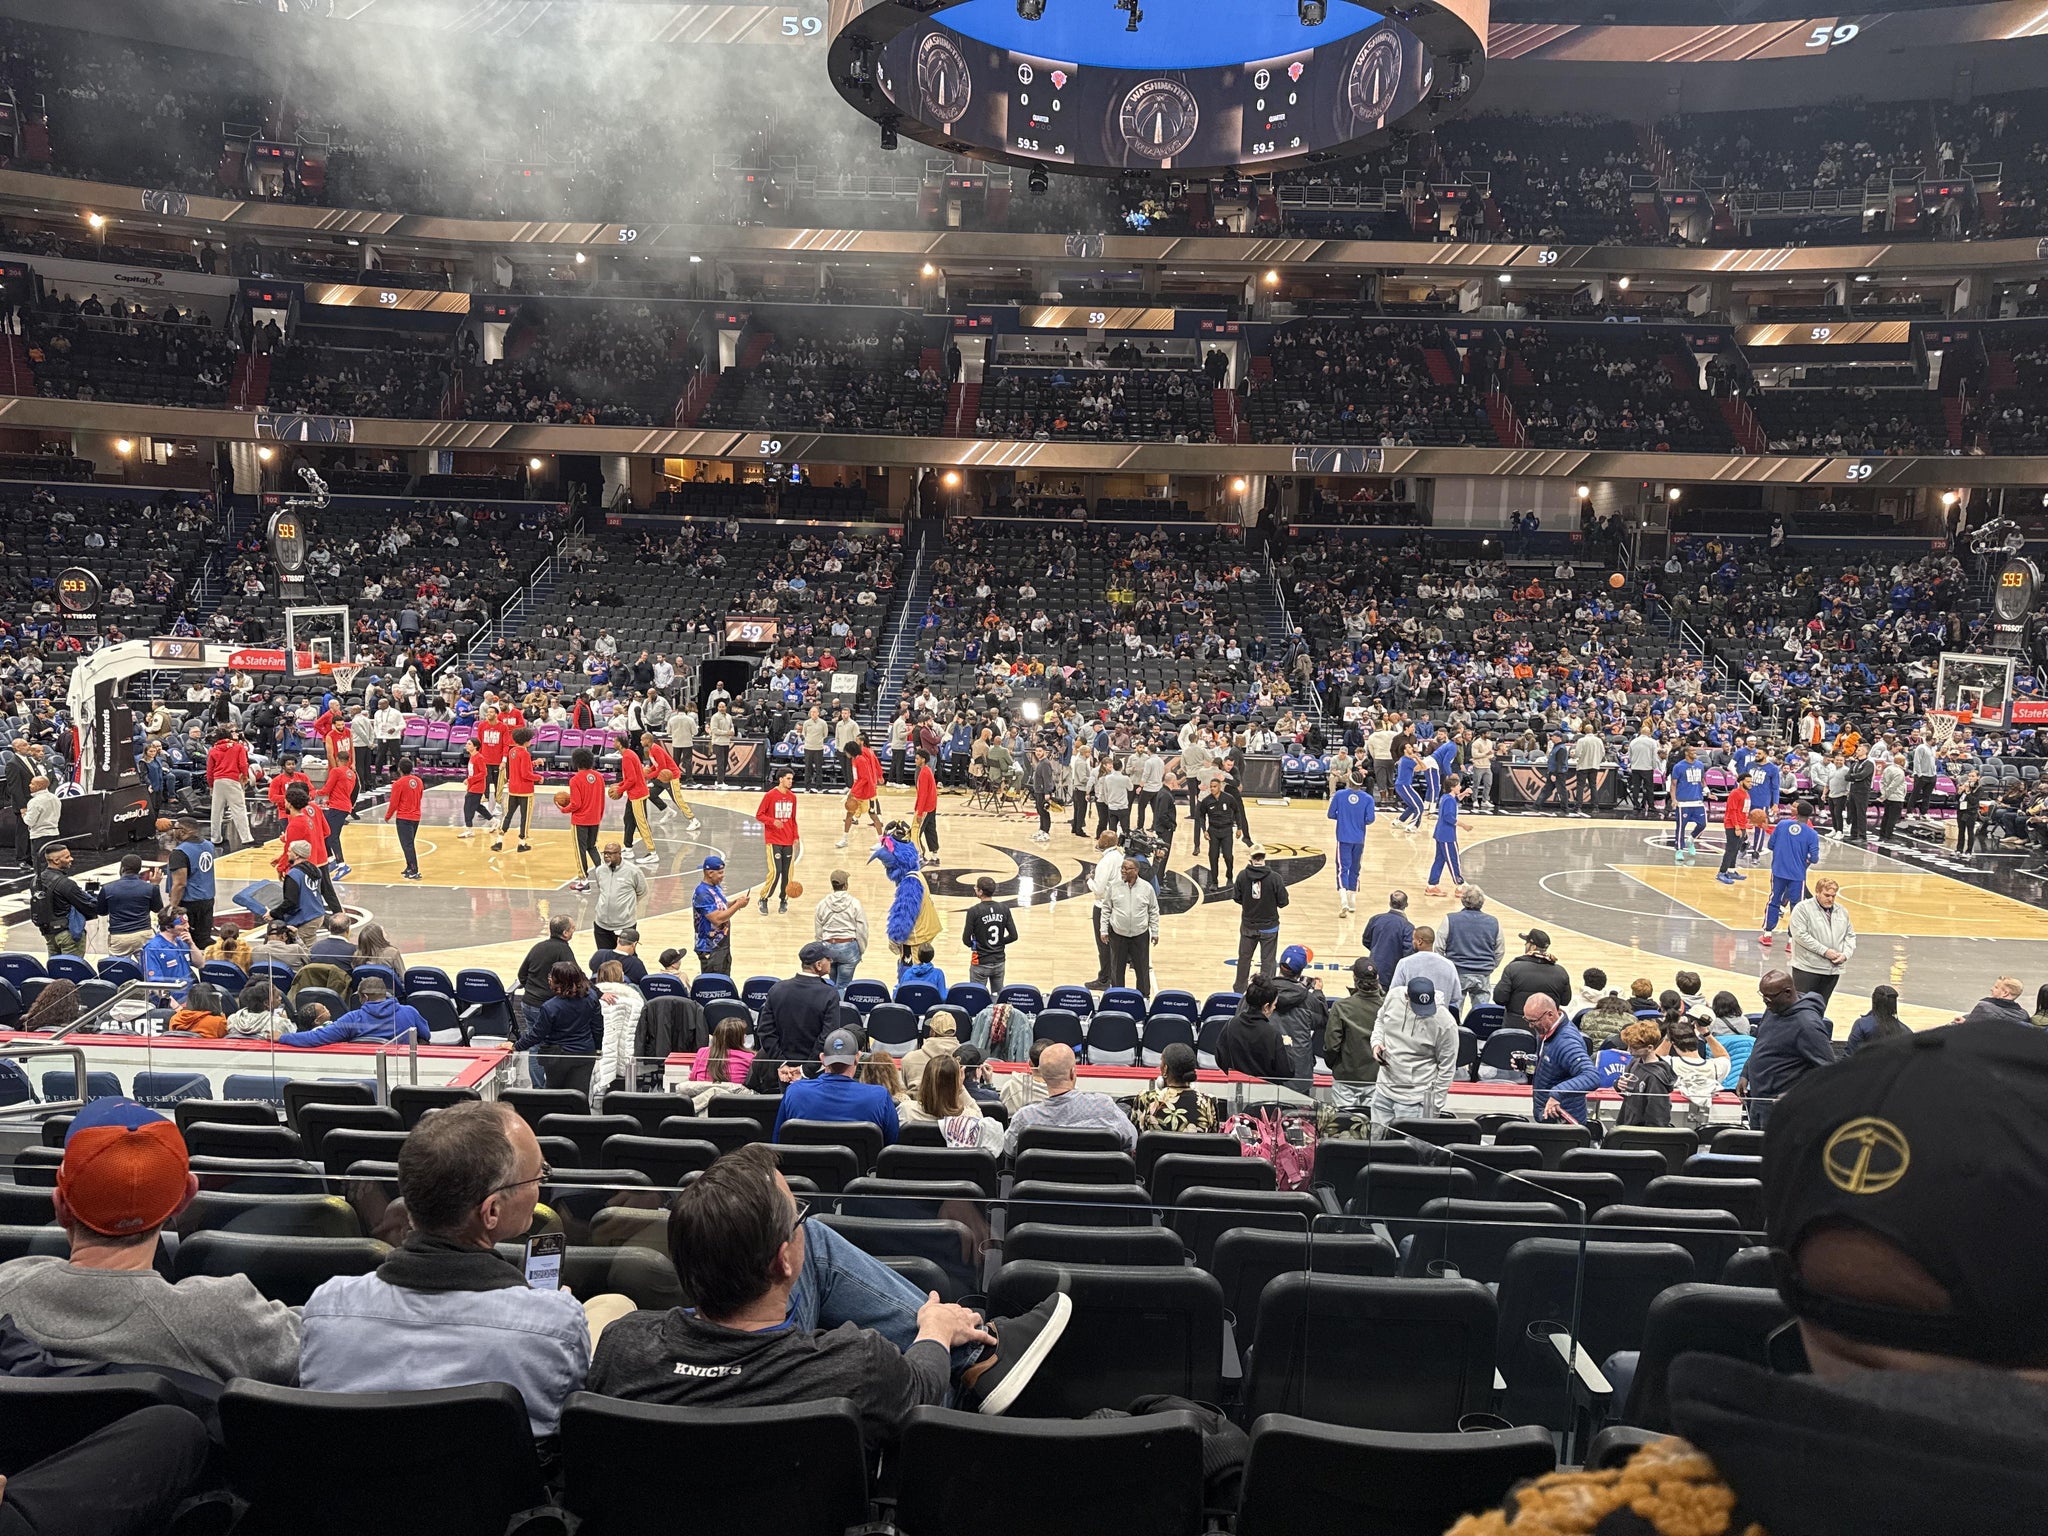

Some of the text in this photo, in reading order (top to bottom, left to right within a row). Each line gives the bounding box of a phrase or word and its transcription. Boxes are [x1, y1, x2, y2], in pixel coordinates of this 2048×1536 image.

[781, 16, 823, 36] 59
[1805, 24, 1859, 47] 59
[1020, 93, 1029, 106] 0
[1052, 99, 1061, 112] 0
[1256, 98, 1265, 111] 0
[1288, 92, 1297, 105] 0
[1017, 137, 1039, 151] 59.5
[1252, 141, 1275, 155] 59.5
[618, 229, 638, 242] 59
[1538, 250, 1558, 264] 59
[379, 292, 397, 304] 59
[1088, 312, 1105, 323] 59
[1811, 327, 1829, 339] 59
[759, 440, 781, 454] 59
[1846, 464, 1872, 480] 59
[63, 580, 86, 592] 59.3
[742, 625, 763, 639] 59
[169, 644, 182, 655] 59
[102, 709, 111, 772] @washwizards
[981, 913, 1004, 924] STARKS
[988, 925, 999, 945] 3
[1604, 1063, 1626, 1077] ANTH
[673, 1362, 742, 1378] KNICKS
